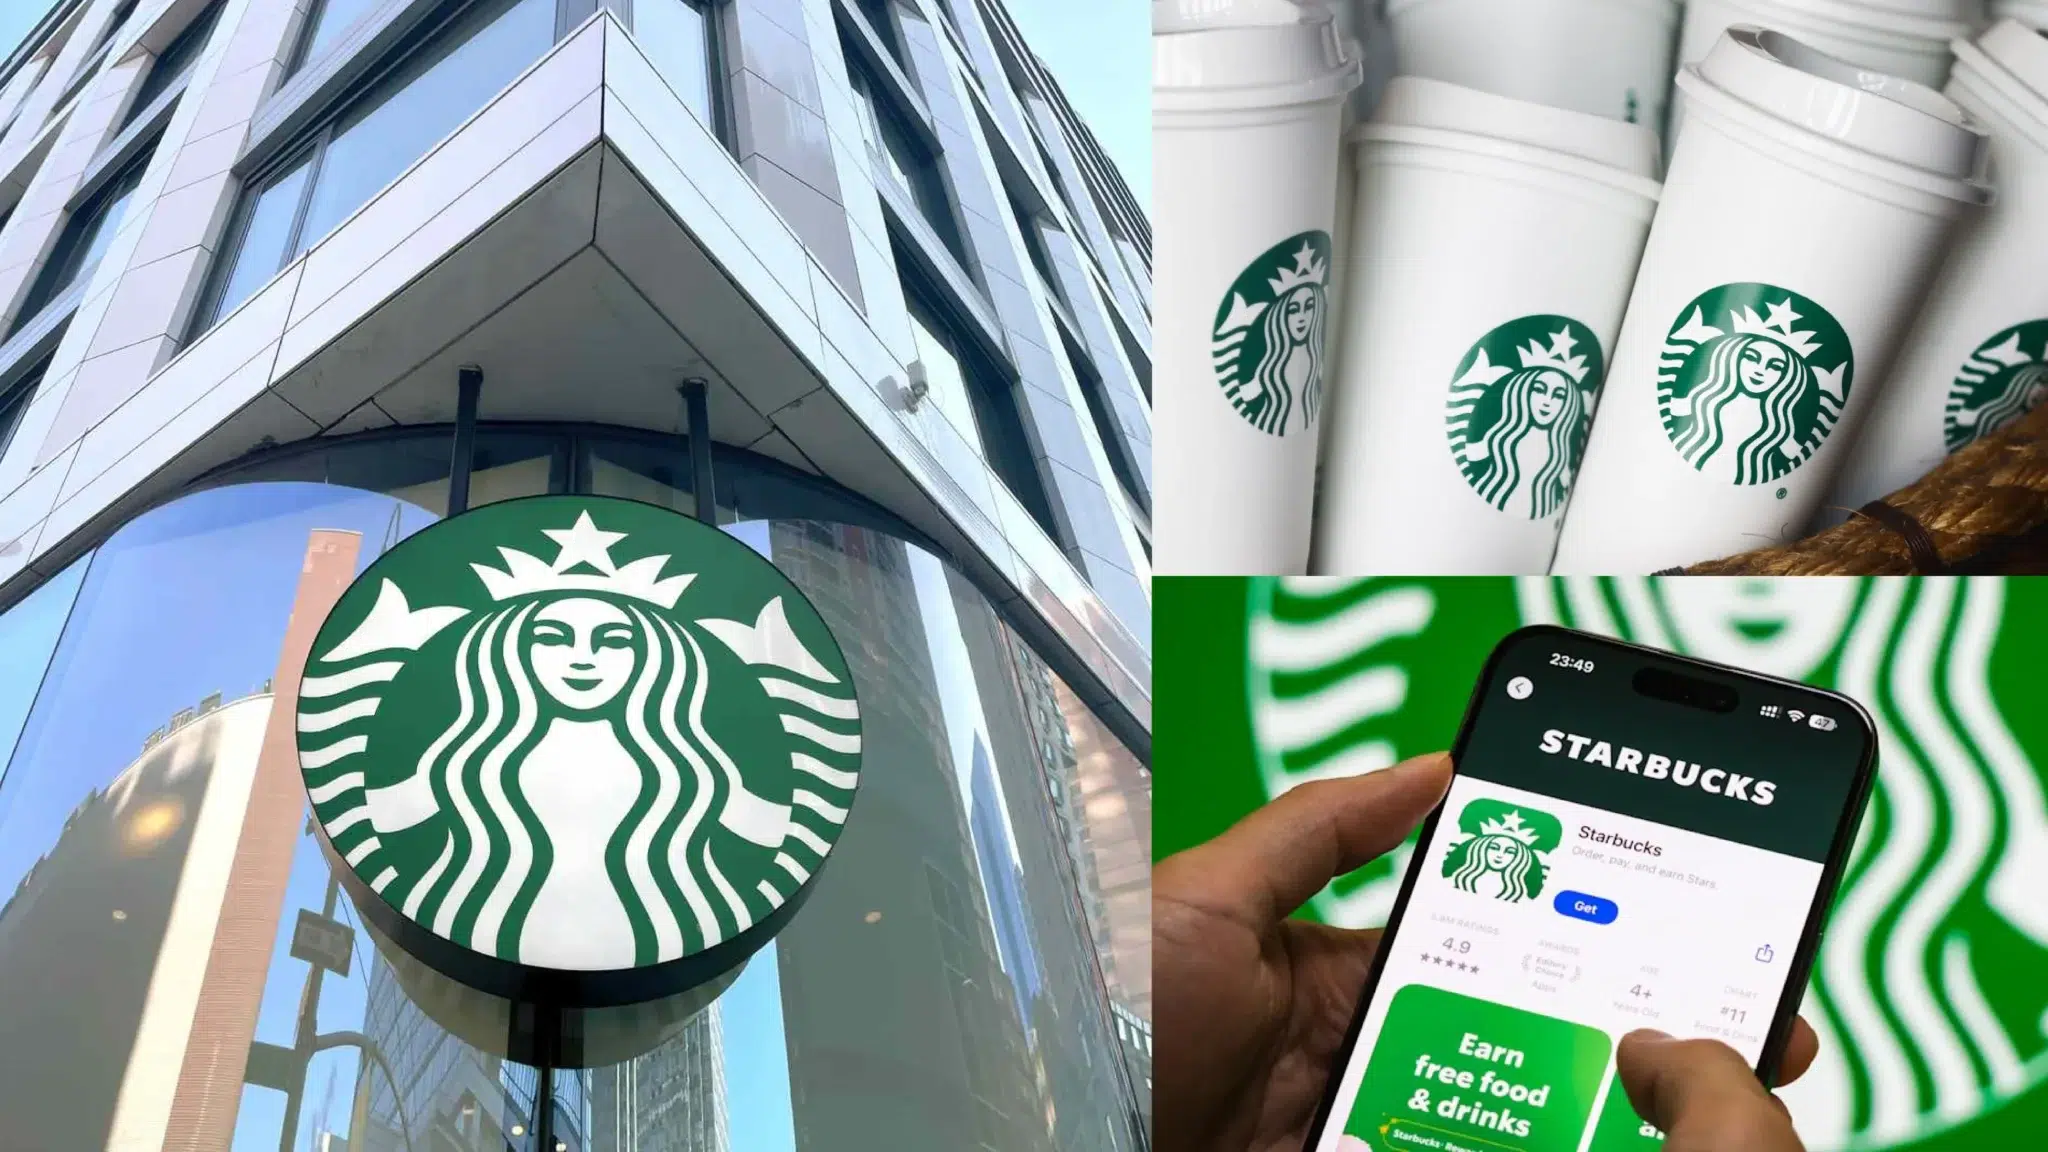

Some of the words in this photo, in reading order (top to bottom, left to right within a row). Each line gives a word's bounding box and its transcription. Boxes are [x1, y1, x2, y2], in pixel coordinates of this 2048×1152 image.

[1549, 653, 1594, 674] 23:49
[1814, 718, 1830, 728] 47
[1539, 729, 1778, 806] STARBUCKS
[1578, 825, 1663, 857] Starbucks
[1572, 845, 1605, 863] Order,
[1608, 854, 1631, 869] pay,
[1634, 862, 1658, 875] and
[1658, 869, 1684, 881] earn
[1574, 900, 1599, 915] Get
[1442, 937, 1471, 954] 4.9
[1629, 984, 1653, 999] 4+
[1720, 1007, 1747, 1024] #11
[1458, 1032, 1525, 1068] Earn
[1414, 1054, 1475, 1089] free
[1479, 1070, 1551, 1108] food
[1407, 1088, 1431, 1112] &
[1437, 1096, 1532, 1137] drinks
